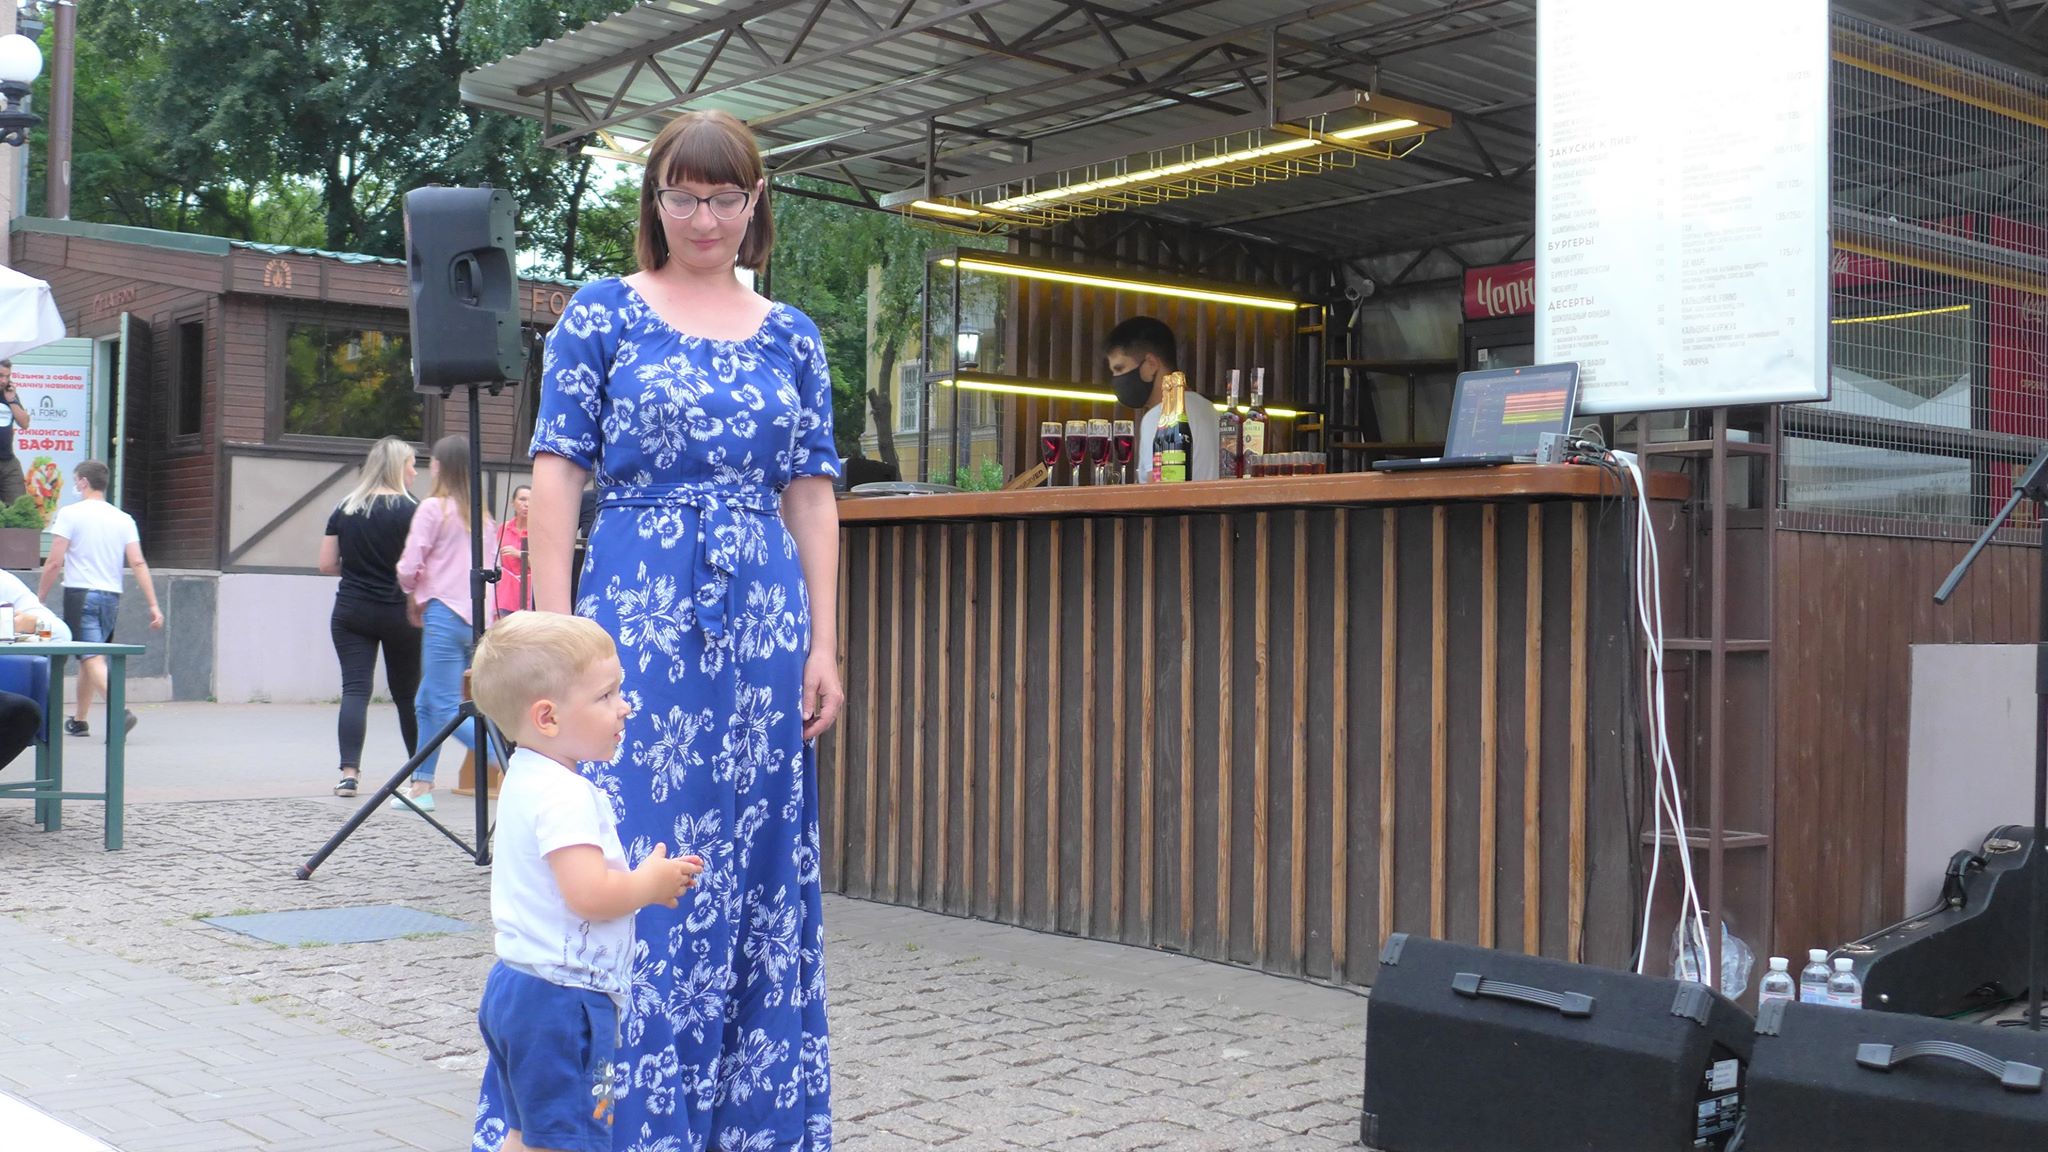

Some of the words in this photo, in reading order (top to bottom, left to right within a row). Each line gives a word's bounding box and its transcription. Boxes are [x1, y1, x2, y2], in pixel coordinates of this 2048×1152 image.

[1549, 141, 1596, 158] ЗАКУСКИ
[1548, 236, 1595, 251] БУРГЕРЫ
[1548, 296, 1595, 311] ДЕСЕРТЫ
[14, 381, 43, 389] мачну
[39, 409, 68, 418] FORNO
[18, 438, 75, 452] ВАФЛІ
